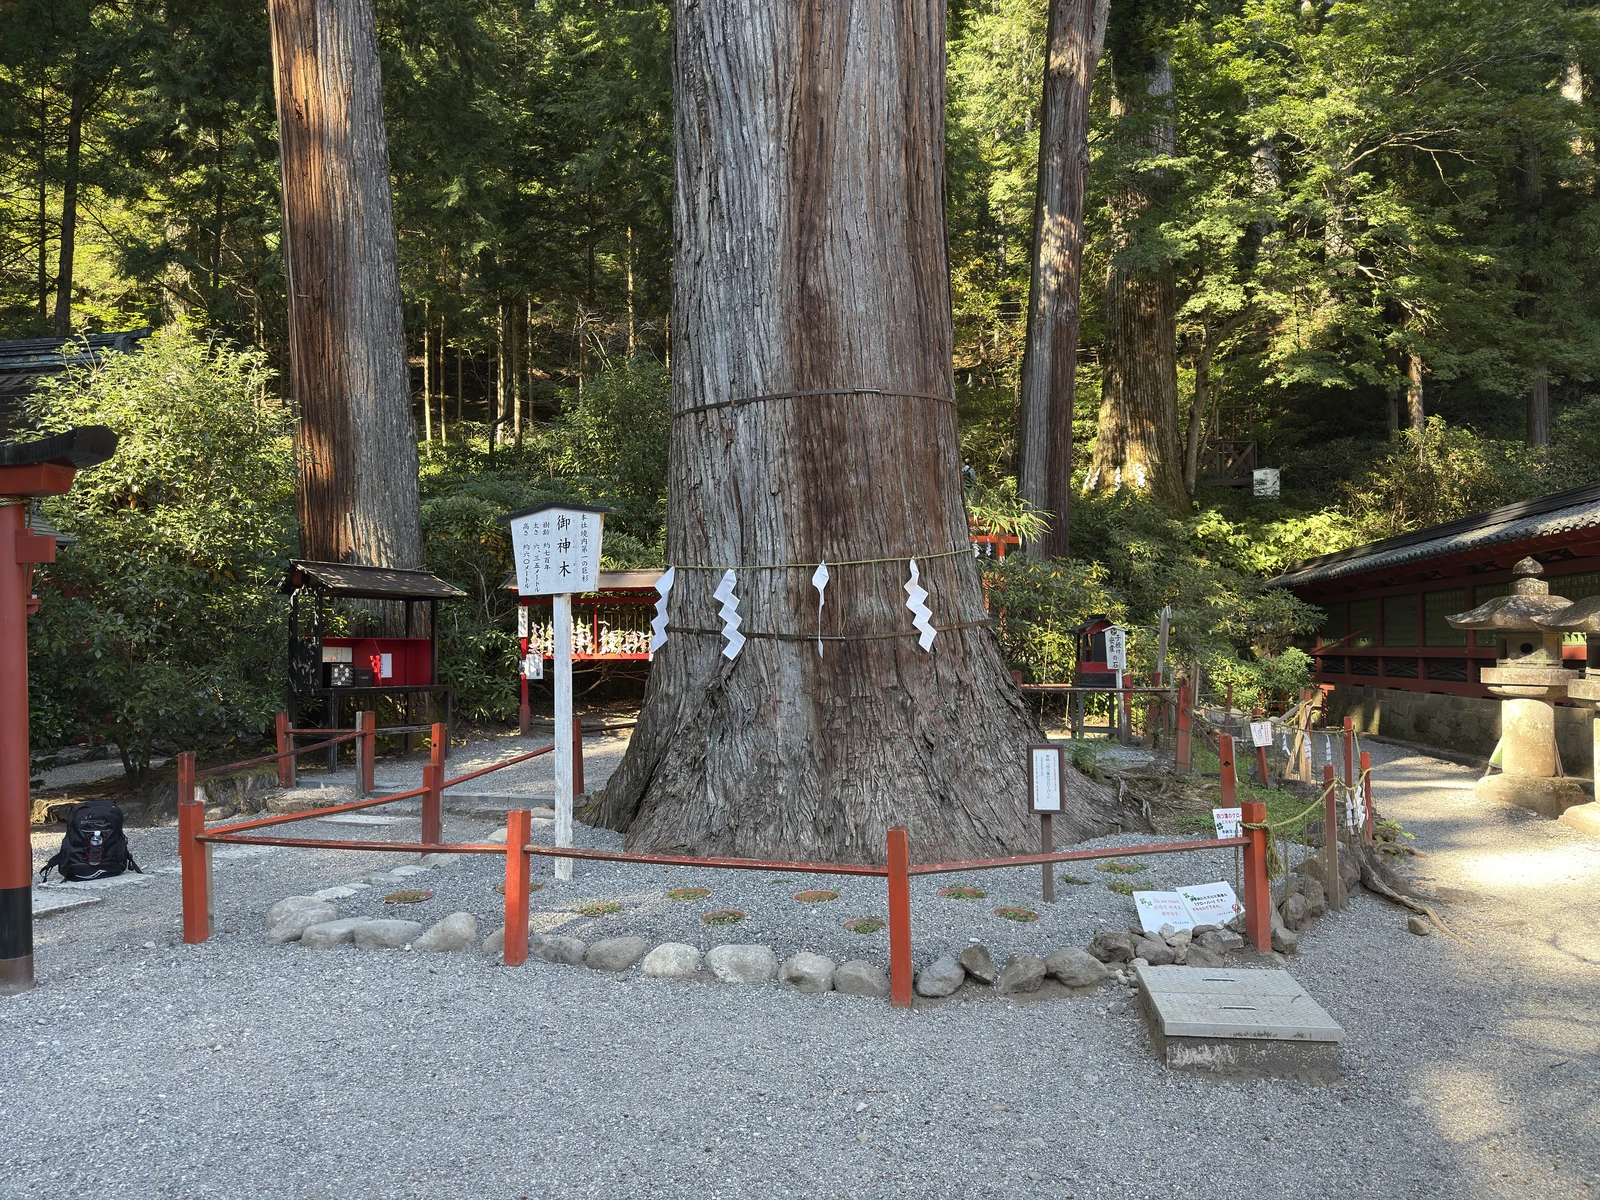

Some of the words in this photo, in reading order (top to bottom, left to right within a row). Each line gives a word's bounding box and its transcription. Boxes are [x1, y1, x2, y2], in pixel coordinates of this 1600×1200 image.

[522, 522, 530, 536] 高さ
[533, 522, 540, 536] 太さ
[543, 542, 551, 571] 約七百年
[556, 514, 571, 578] 御神木
[580, 513, 589, 583] 本社境内第一の巨杉
